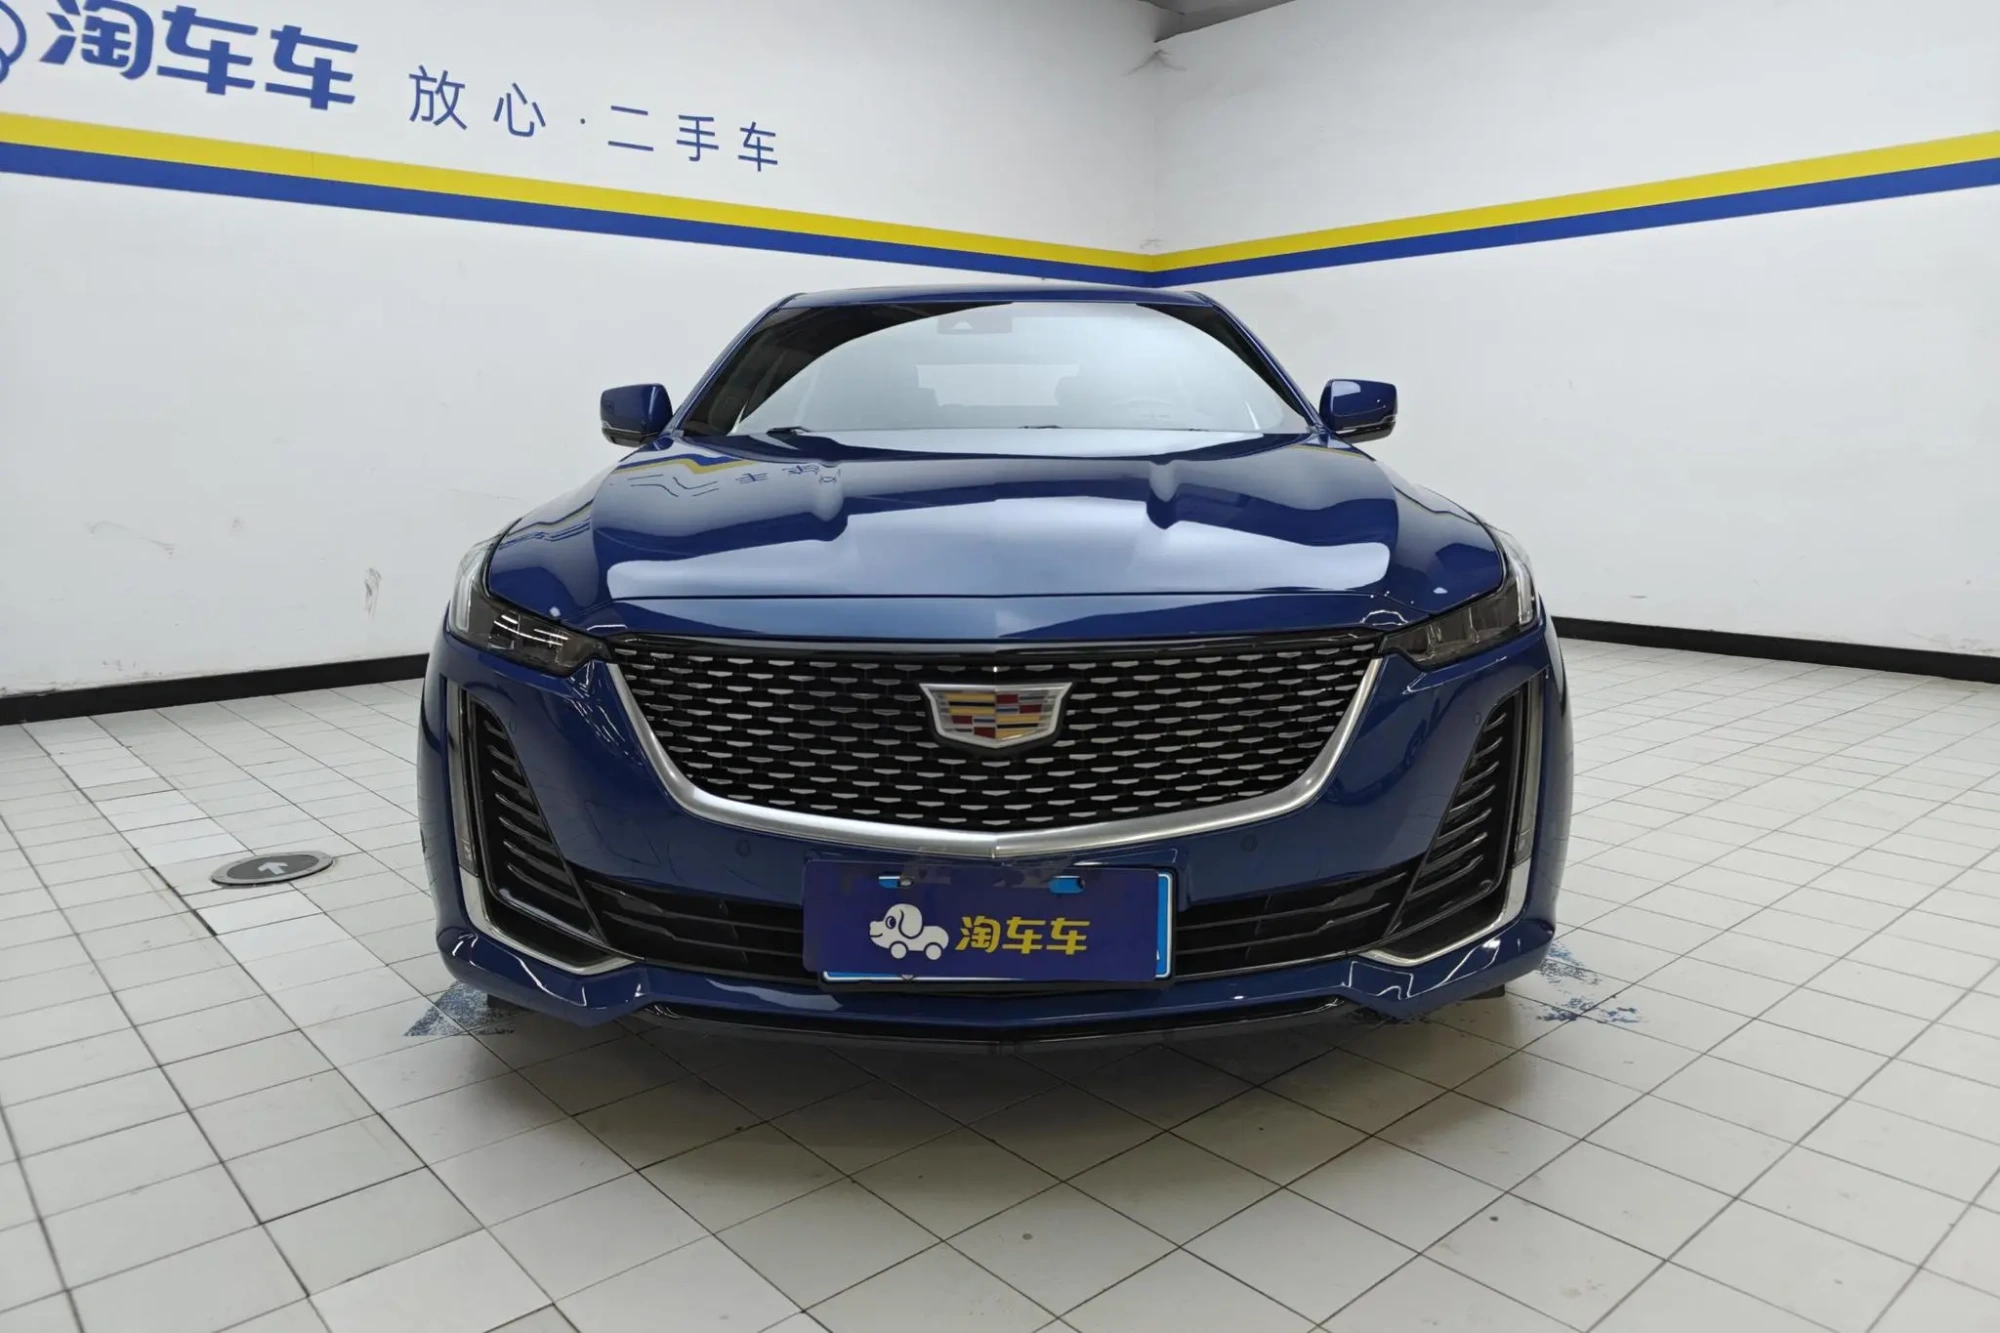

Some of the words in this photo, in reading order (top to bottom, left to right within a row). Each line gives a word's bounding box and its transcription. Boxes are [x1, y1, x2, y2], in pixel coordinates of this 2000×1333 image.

[40, 0, 358, 110] 淘车车
[955, 915, 1091, 956] 淘车车
